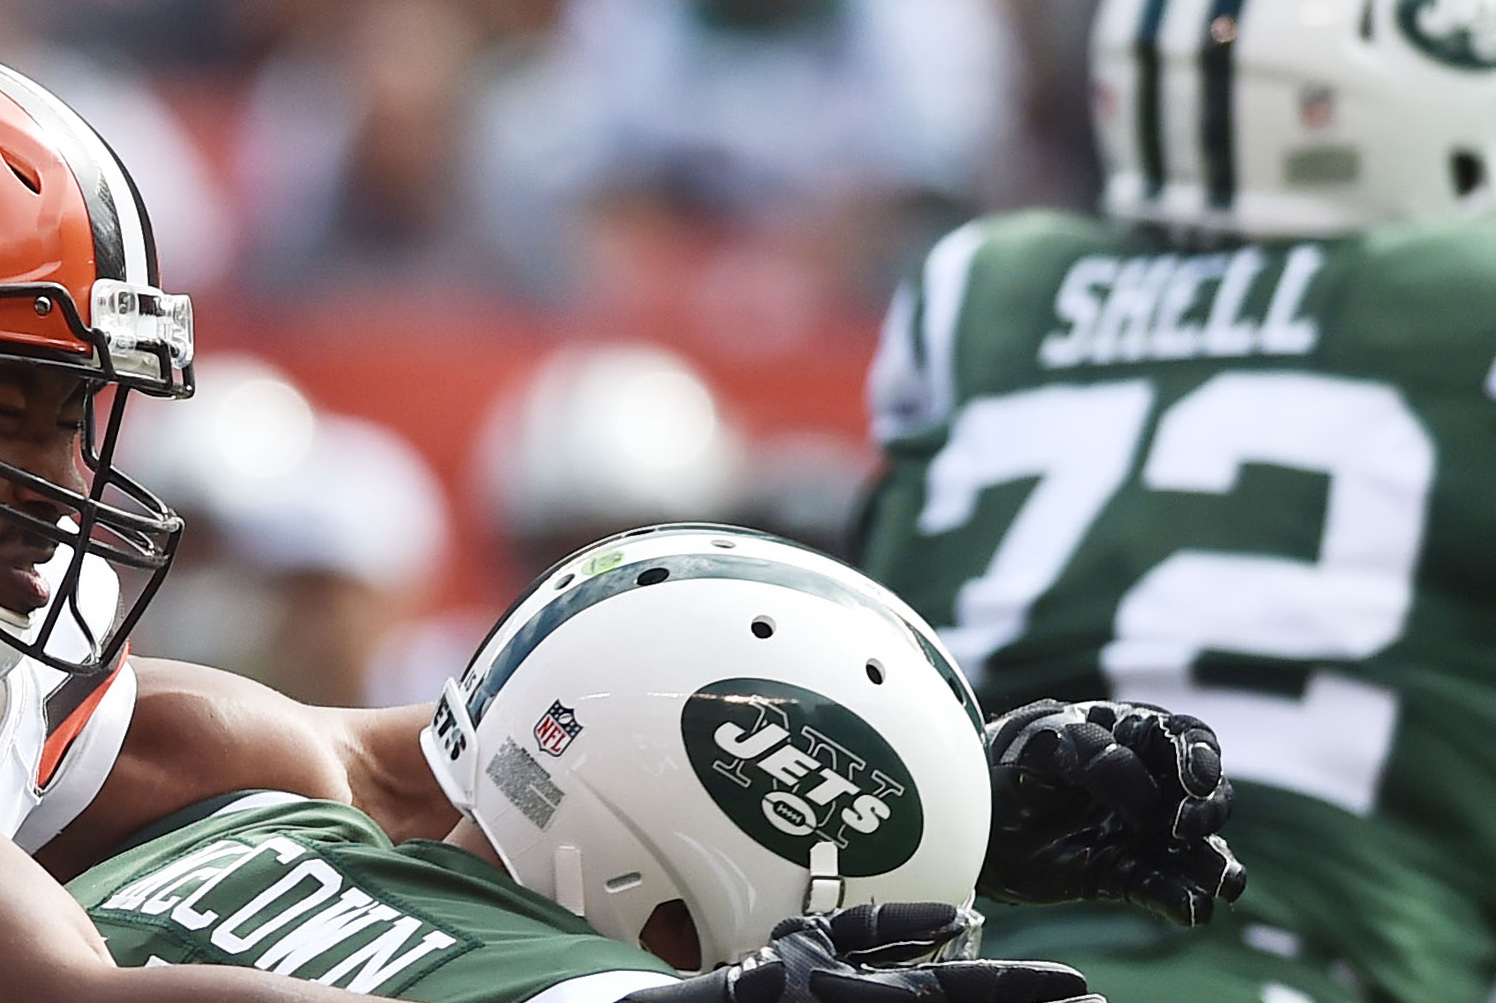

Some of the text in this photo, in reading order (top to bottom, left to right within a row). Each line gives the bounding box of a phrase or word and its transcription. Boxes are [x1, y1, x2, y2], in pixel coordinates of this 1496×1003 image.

[1039, 244, 1327, 369] SHELL
[920, 370, 1436, 816] 72
[537, 716, 566, 752] NFL
[713, 720, 892, 834] JETS
